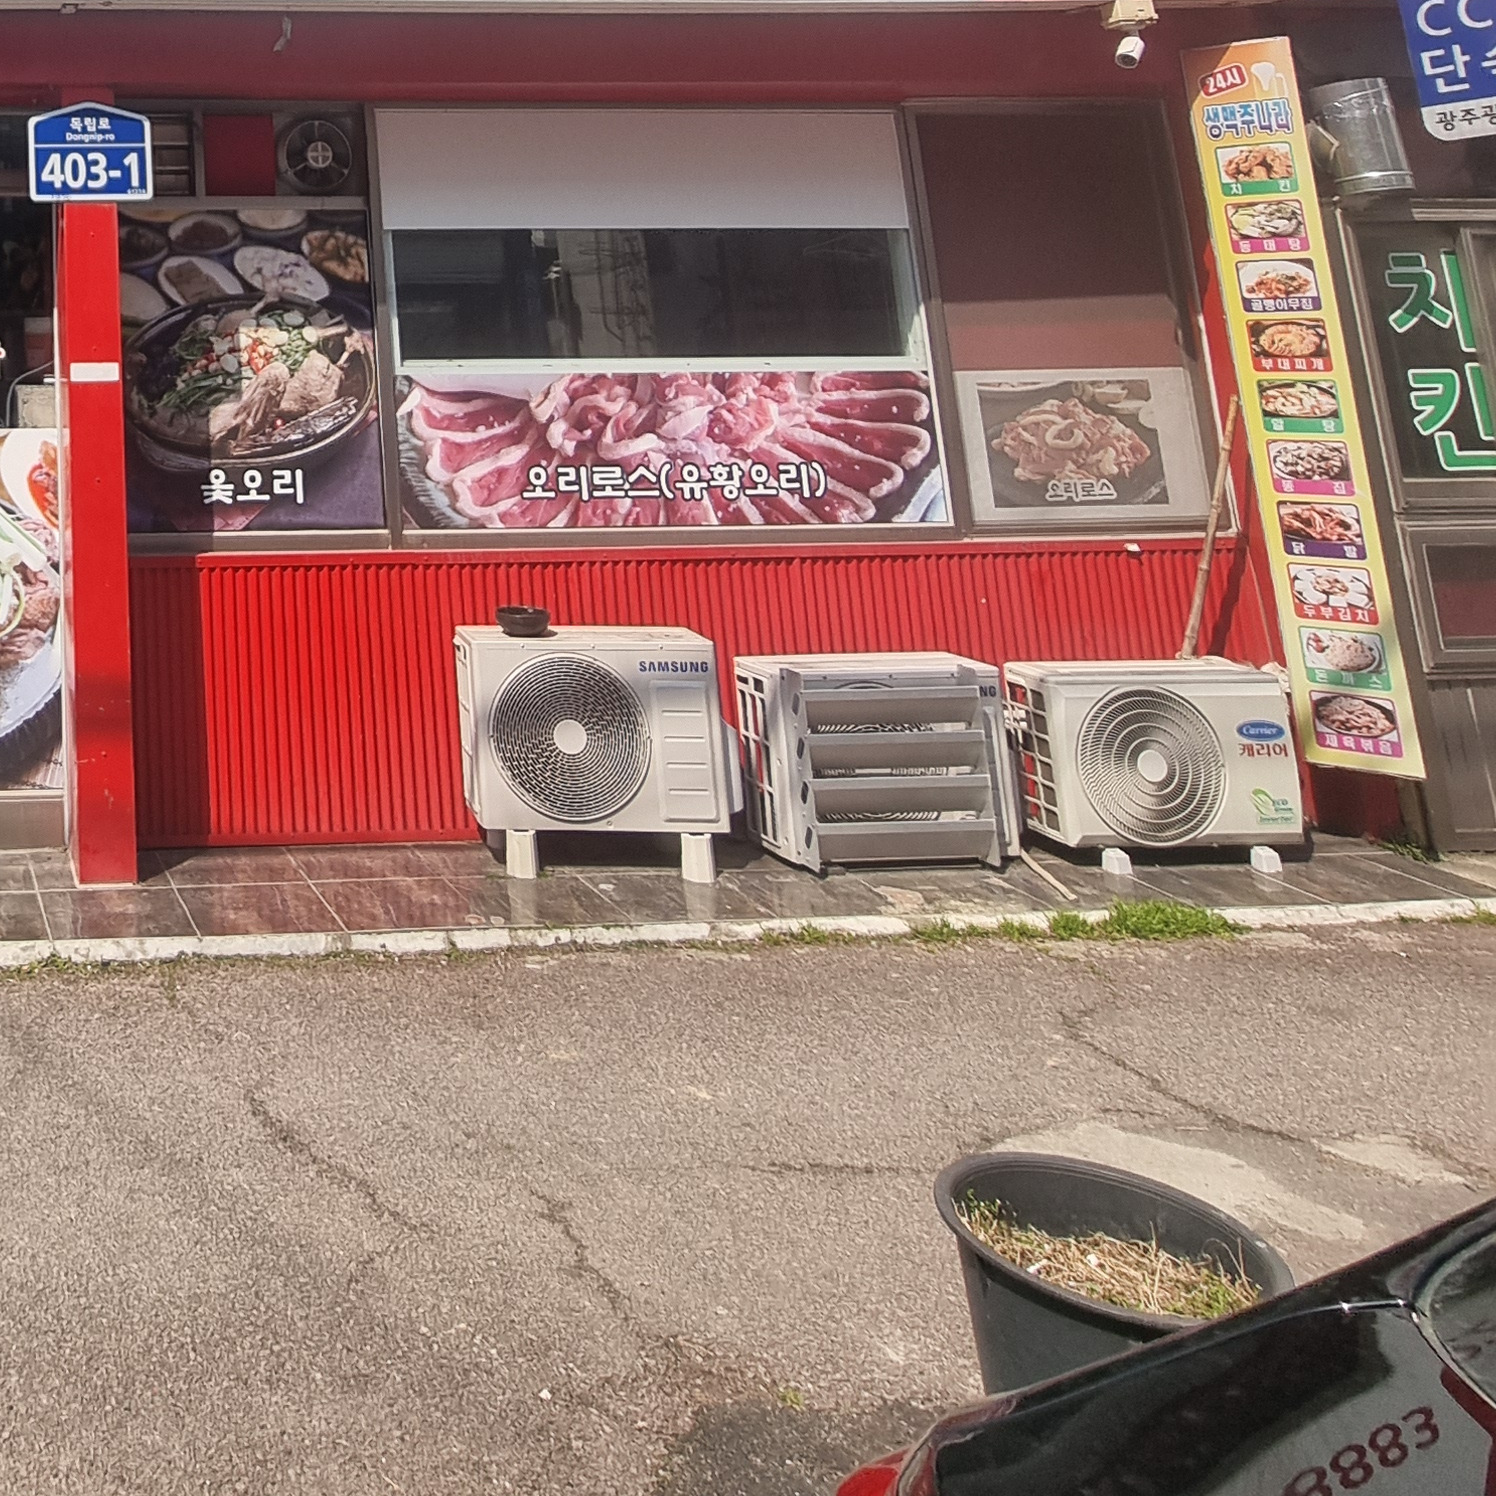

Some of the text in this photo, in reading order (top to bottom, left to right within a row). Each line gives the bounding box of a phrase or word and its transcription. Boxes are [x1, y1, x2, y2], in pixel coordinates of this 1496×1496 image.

[1206, 67, 1242, 94] 24시
[69, 116, 111, 132] 독립로
[1203, 99, 1292, 140] 생맥주나라
[66, 132, 115, 143] Dongnip-ro
[41, 152, 140, 189] 403-1
[200, 468, 304, 505] 옻오리
[522, 461, 827, 501] 오리로스(유황오리)
[1045, 479, 1117, 501] 오리로스
[1303, 604, 1371, 623] 두부김치
[638, 660, 709, 673] SAMSUNG
[1242, 725, 1278, 736] Carrier
[1239, 743, 1289, 757] 캐리어
